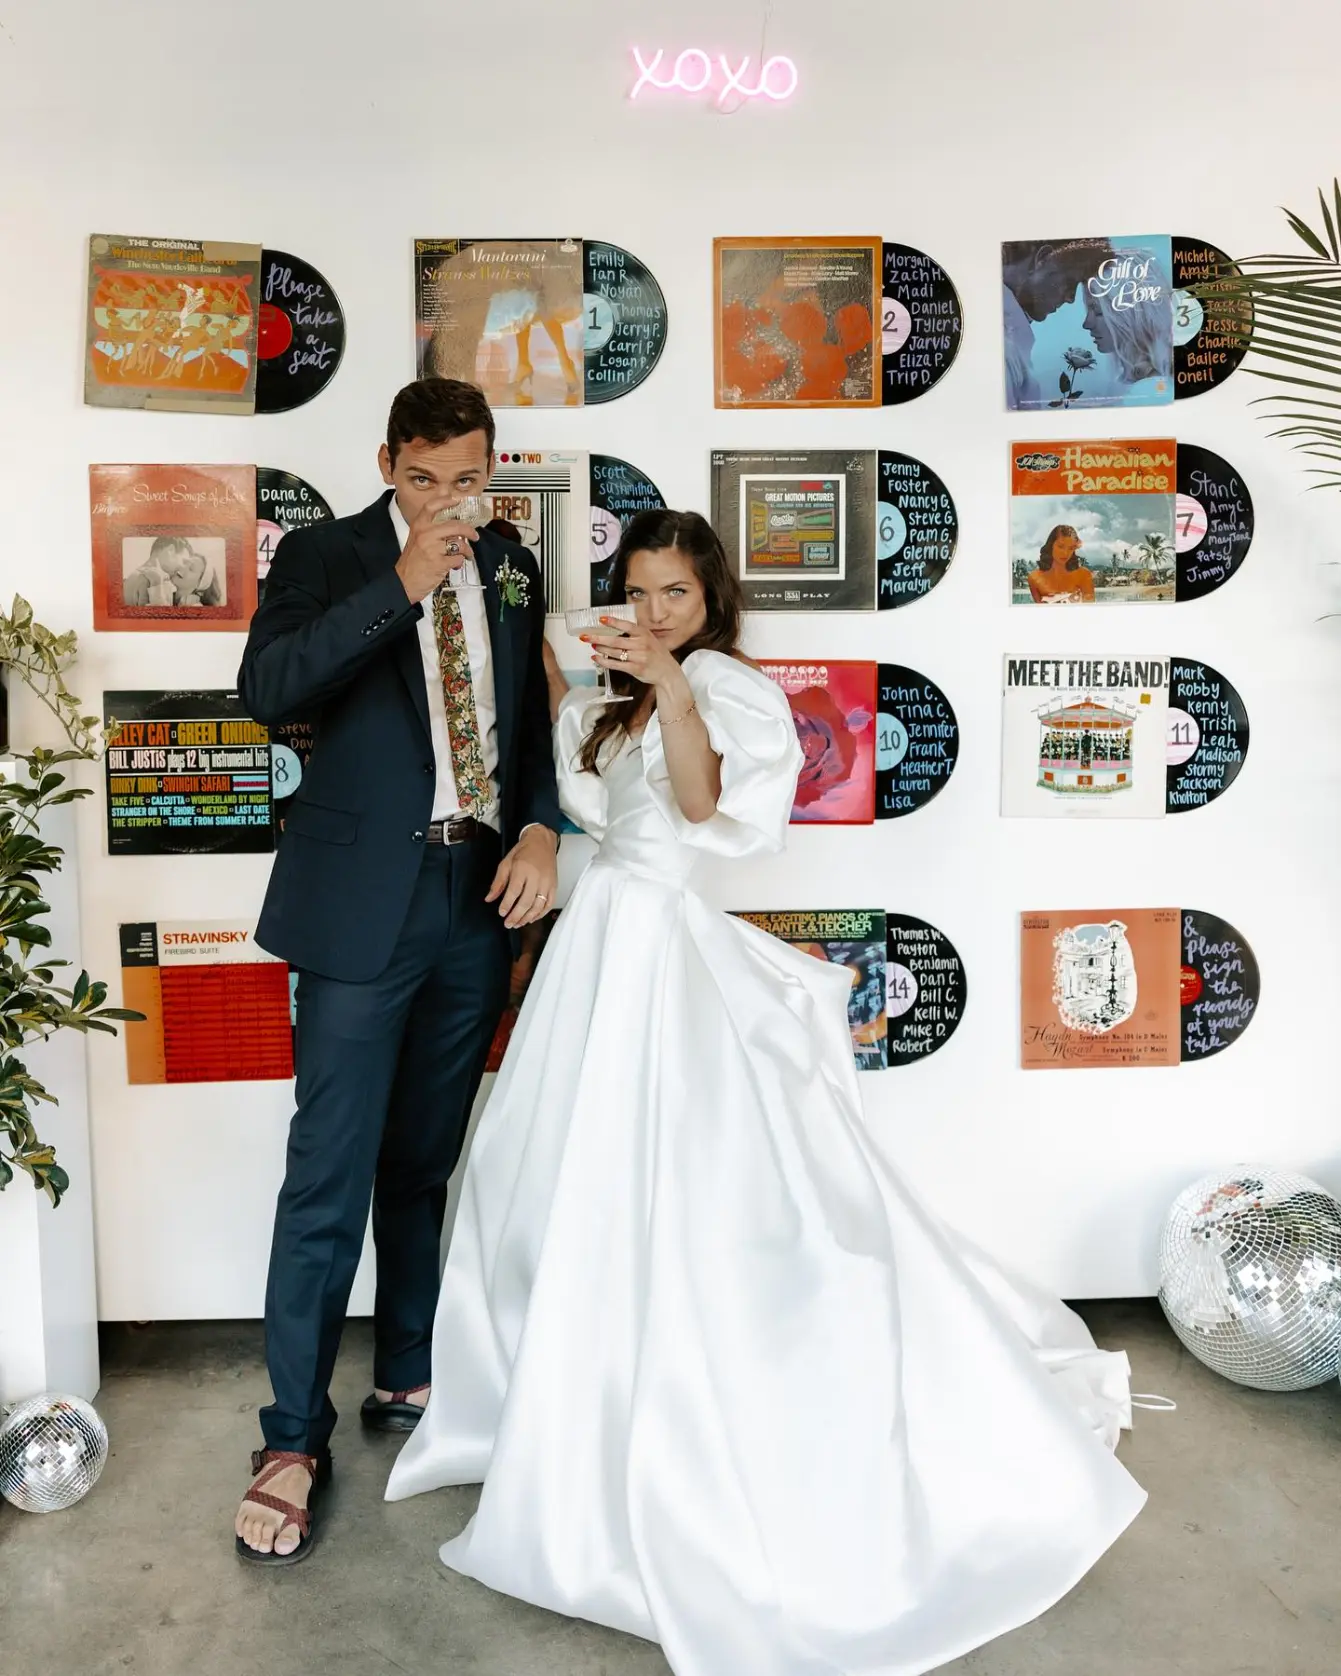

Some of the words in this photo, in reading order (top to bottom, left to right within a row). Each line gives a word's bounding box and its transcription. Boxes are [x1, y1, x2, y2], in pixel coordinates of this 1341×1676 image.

[128, 239, 149, 247] THE
[152, 240, 200, 250] ORIGINAL
[470, 248, 547, 264] Mantovani
[589, 252, 624, 268] Emily
[885, 252, 930, 268] Morgan
[1174, 250, 1216, 264] Michele
[422, 266, 476, 281] Strauss
[480, 266, 530, 282] Waltzes
[593, 269, 615, 282] Ian
[890, 269, 929, 283] Zach
[932, 269, 945, 281] H.
[600, 284, 642, 299] Noyan
[898, 284, 933, 299] Madi
[1112, 281, 1161, 312] Love
[289, 302, 337, 324] take
[611, 303, 661, 319] Thomas
[911, 300, 954, 314] Daniel
[588, 307, 602, 330] 1
[882, 311, 898, 332] 2
[1177, 306, 1190, 327] 3
[615, 322, 650, 339] Jerry
[914, 318, 950, 332] Tyler
[306, 334, 319, 346] a
[909, 336, 951, 350] Jarvis
[288, 346, 336, 374] seat
[600, 355, 637, 368] Logan
[900, 354, 931, 368] Eliza
[1187, 352, 1227, 367] Bailee
[588, 369, 624, 382] Collin
[886, 370, 918, 386] Trip
[521, 454, 541, 464] TWO
[1061, 447, 1174, 469] Hawaiian
[594, 465, 627, 479] Scott
[882, 463, 920, 477] Jenny
[888, 479, 930, 493] Foster
[1061, 470, 1169, 492] Paradise
[1190, 470, 1228, 498] Stan
[133, 484, 168, 502] Sweet
[171, 484, 206, 508] Songs
[209, 486, 218, 507] of
[261, 489, 297, 501] Dana
[300, 488, 312, 502] G.
[765, 493, 783, 502] GREAT
[784, 493, 805, 501] MOTION
[807, 493, 834, 501] PICTURES
[607, 497, 663, 510] Samantha
[898, 495, 938, 511] Nancy
[275, 506, 325, 520] Monica
[909, 511, 942, 525] Steve
[880, 516, 894, 542] 6
[1177, 512, 1194, 537] 7
[1211, 519, 1236, 532] John
[592, 523, 607, 545] 5
[910, 529, 938, 543] Pam
[259, 534, 274, 562] 4
[903, 546, 938, 561] Glenn
[1196, 551, 1232, 569] Patsy
[892, 562, 926, 577] Jeff
[1187, 566, 1224, 582] Jimmy
[881, 578, 932, 595] Maralyn
[1008, 660, 1063, 686] MEET
[1066, 660, 1104, 687] THE
[1107, 661, 1169, 688] BAND!
[1173, 666, 1205, 680] Mark
[882, 687, 919, 701] John
[924, 685, 938, 701] C.
[1178, 683, 1220, 699] Robby
[896, 704, 933, 719] Tina
[936, 703, 949, 719] C.
[1188, 700, 1229, 716] Kenny
[908, 721, 957, 738] Jennifer
[1200, 715, 1237, 732] Trish
[148, 723, 170, 745] CAT
[177, 722, 217, 745] GREEN
[221, 722, 268, 744] ONIONS
[880, 730, 900, 751] 10
[1172, 723, 1193, 745] 11
[1202, 734, 1238, 749] Leah
[910, 741, 947, 758] Frank
[1195, 749, 1241, 762] Madison
[109, 750, 129, 769] BILL
[186, 750, 196, 768] 12
[212, 748, 254, 767] instrumental
[255, 748, 268, 767] hits
[275, 757, 288, 782] 8
[900, 761, 944, 776] Heather
[1185, 764, 1224, 777] Stormy
[201, 776, 230, 791] SAFARI
[892, 778, 931, 793] Lauren
[1177, 777, 1223, 790] Jackson
[111, 797, 128, 806] TAKE
[130, 797, 144, 805] FIVE
[151, 796, 185, 805] CALCUTTA
[191, 795, 237, 804] WONDERLAND
[249, 794, 269, 803] NIGHT
[884, 795, 915, 809] Lisa
[111, 807, 146, 816] STRANGER
[159, 807, 172, 816] THE
[173, 806, 196, 815] SHORE
[202, 806, 228, 814] MEXICO
[235, 805, 252, 814] LAST
[253, 805, 270, 814] DATE
[112, 818, 126, 827] THE
[127, 817, 162, 827] STRIPPER
[168, 817, 192, 826] THEME
[194, 816, 214, 825] FROM
[215, 816, 247, 825] SUMMER
[248, 815, 270, 825] PLACE
[770, 913, 816, 922] EXCITING
[818, 913, 856, 922] PIANOS
[858, 913, 872, 921] OF
[817, 921, 872, 931] TEICHER
[1184, 916, 1198, 937] &
[163, 931, 248, 945] STRAVINSKY
[890, 928, 929, 940] Thomas
[897, 943, 937, 956] Payton
[1185, 936, 1243, 964] please
[910, 957, 959, 971] Benjamin
[1203, 959, 1245, 981] sign
[920, 973, 945, 986] Dan
[1209, 978, 1243, 994] the
[888, 977, 910, 998] 14
[921, 989, 941, 1003] Bill
[946, 988, 957, 1002] C.
[1193, 993, 1254, 1018] records
[915, 1006, 940, 1022] Kelli
[944, 1007, 958, 1020] W.
[903, 1024, 932, 1037] Mike
[1025, 1023, 1072, 1045] Haydn
[1187, 1019, 1203, 1036] at
[1208, 1017, 1243, 1033] your
[893, 1038, 934, 1053] Robert
[1185, 1035, 1228, 1053] table
